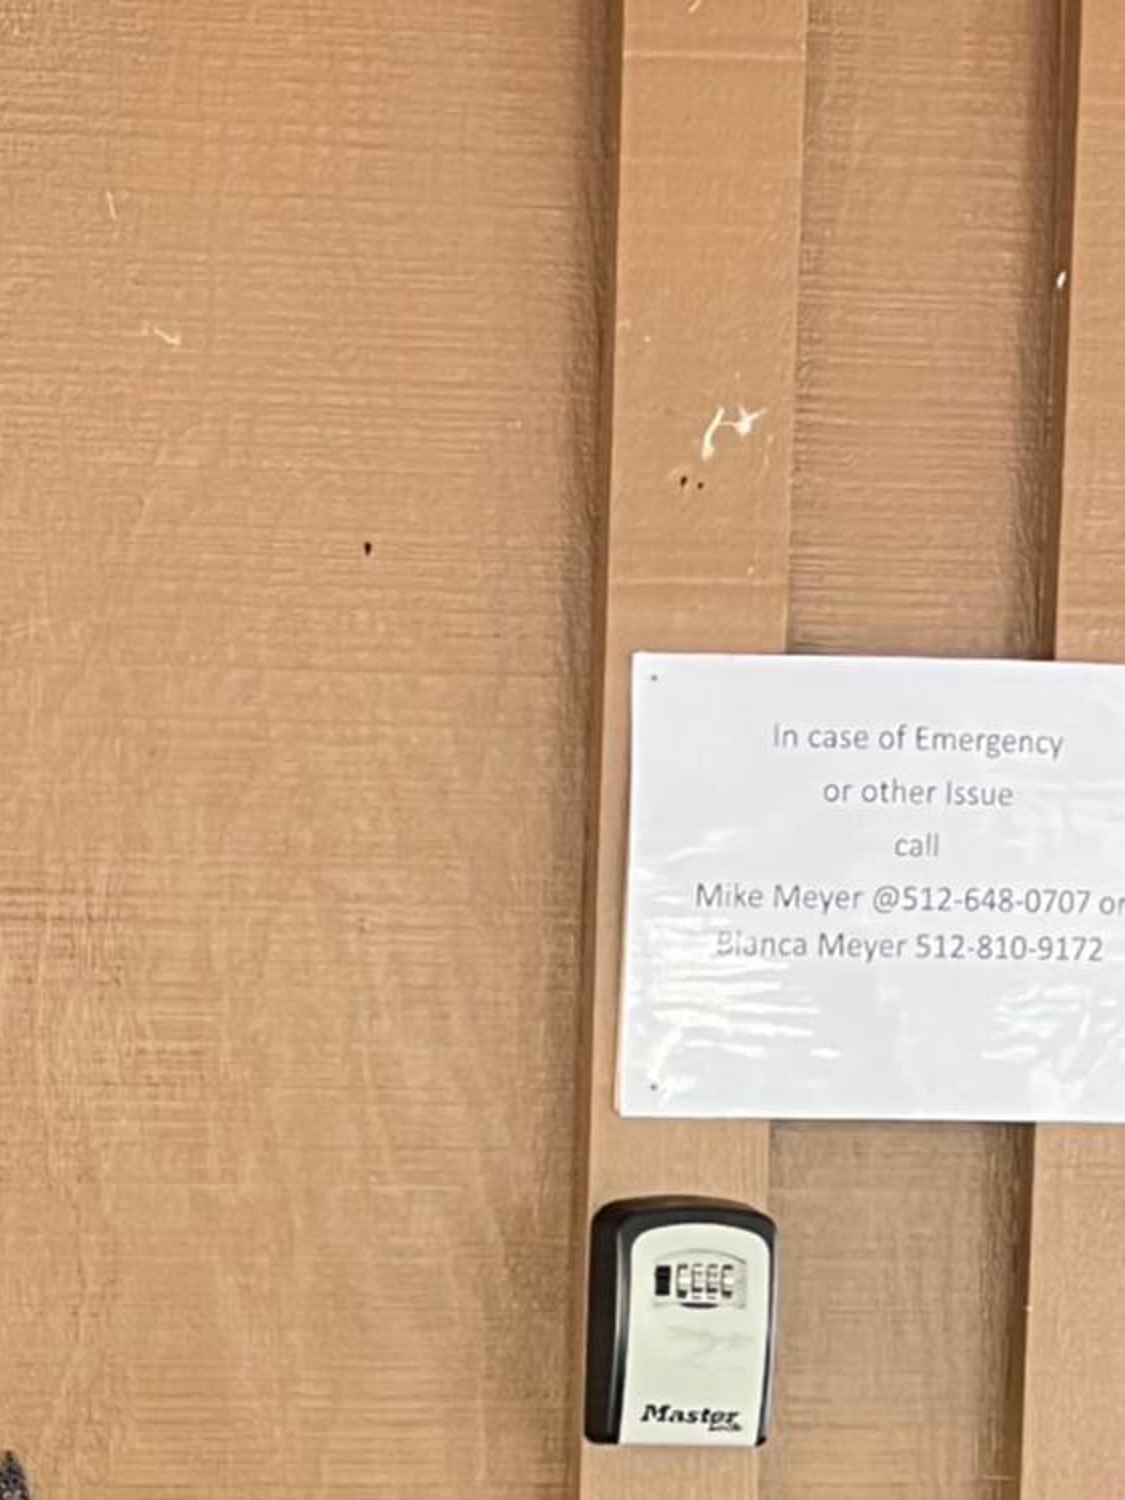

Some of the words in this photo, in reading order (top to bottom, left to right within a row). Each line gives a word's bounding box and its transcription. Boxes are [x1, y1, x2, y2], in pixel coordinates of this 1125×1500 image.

[773, 723, 798, 748] In
[808, 728, 869, 750] case
[878, 723, 908, 750] of
[915, 726, 1064, 760] Emergency
[823, 783, 852, 803] or
[861, 778, 936, 805] other
[945, 781, 1014, 806] Issue
[894, 832, 939, 857] call
[696, 882, 764, 909] Mike
[774, 884, 864, 915] Meyer
[873, 885, 1091, 915] @512-648-0707
[717, 930, 807, 958] Bianca
[818, 932, 907, 964] Meyer
[915, 933, 1103, 962] 512-810-9172
[641, 1404, 739, 1424] Master
